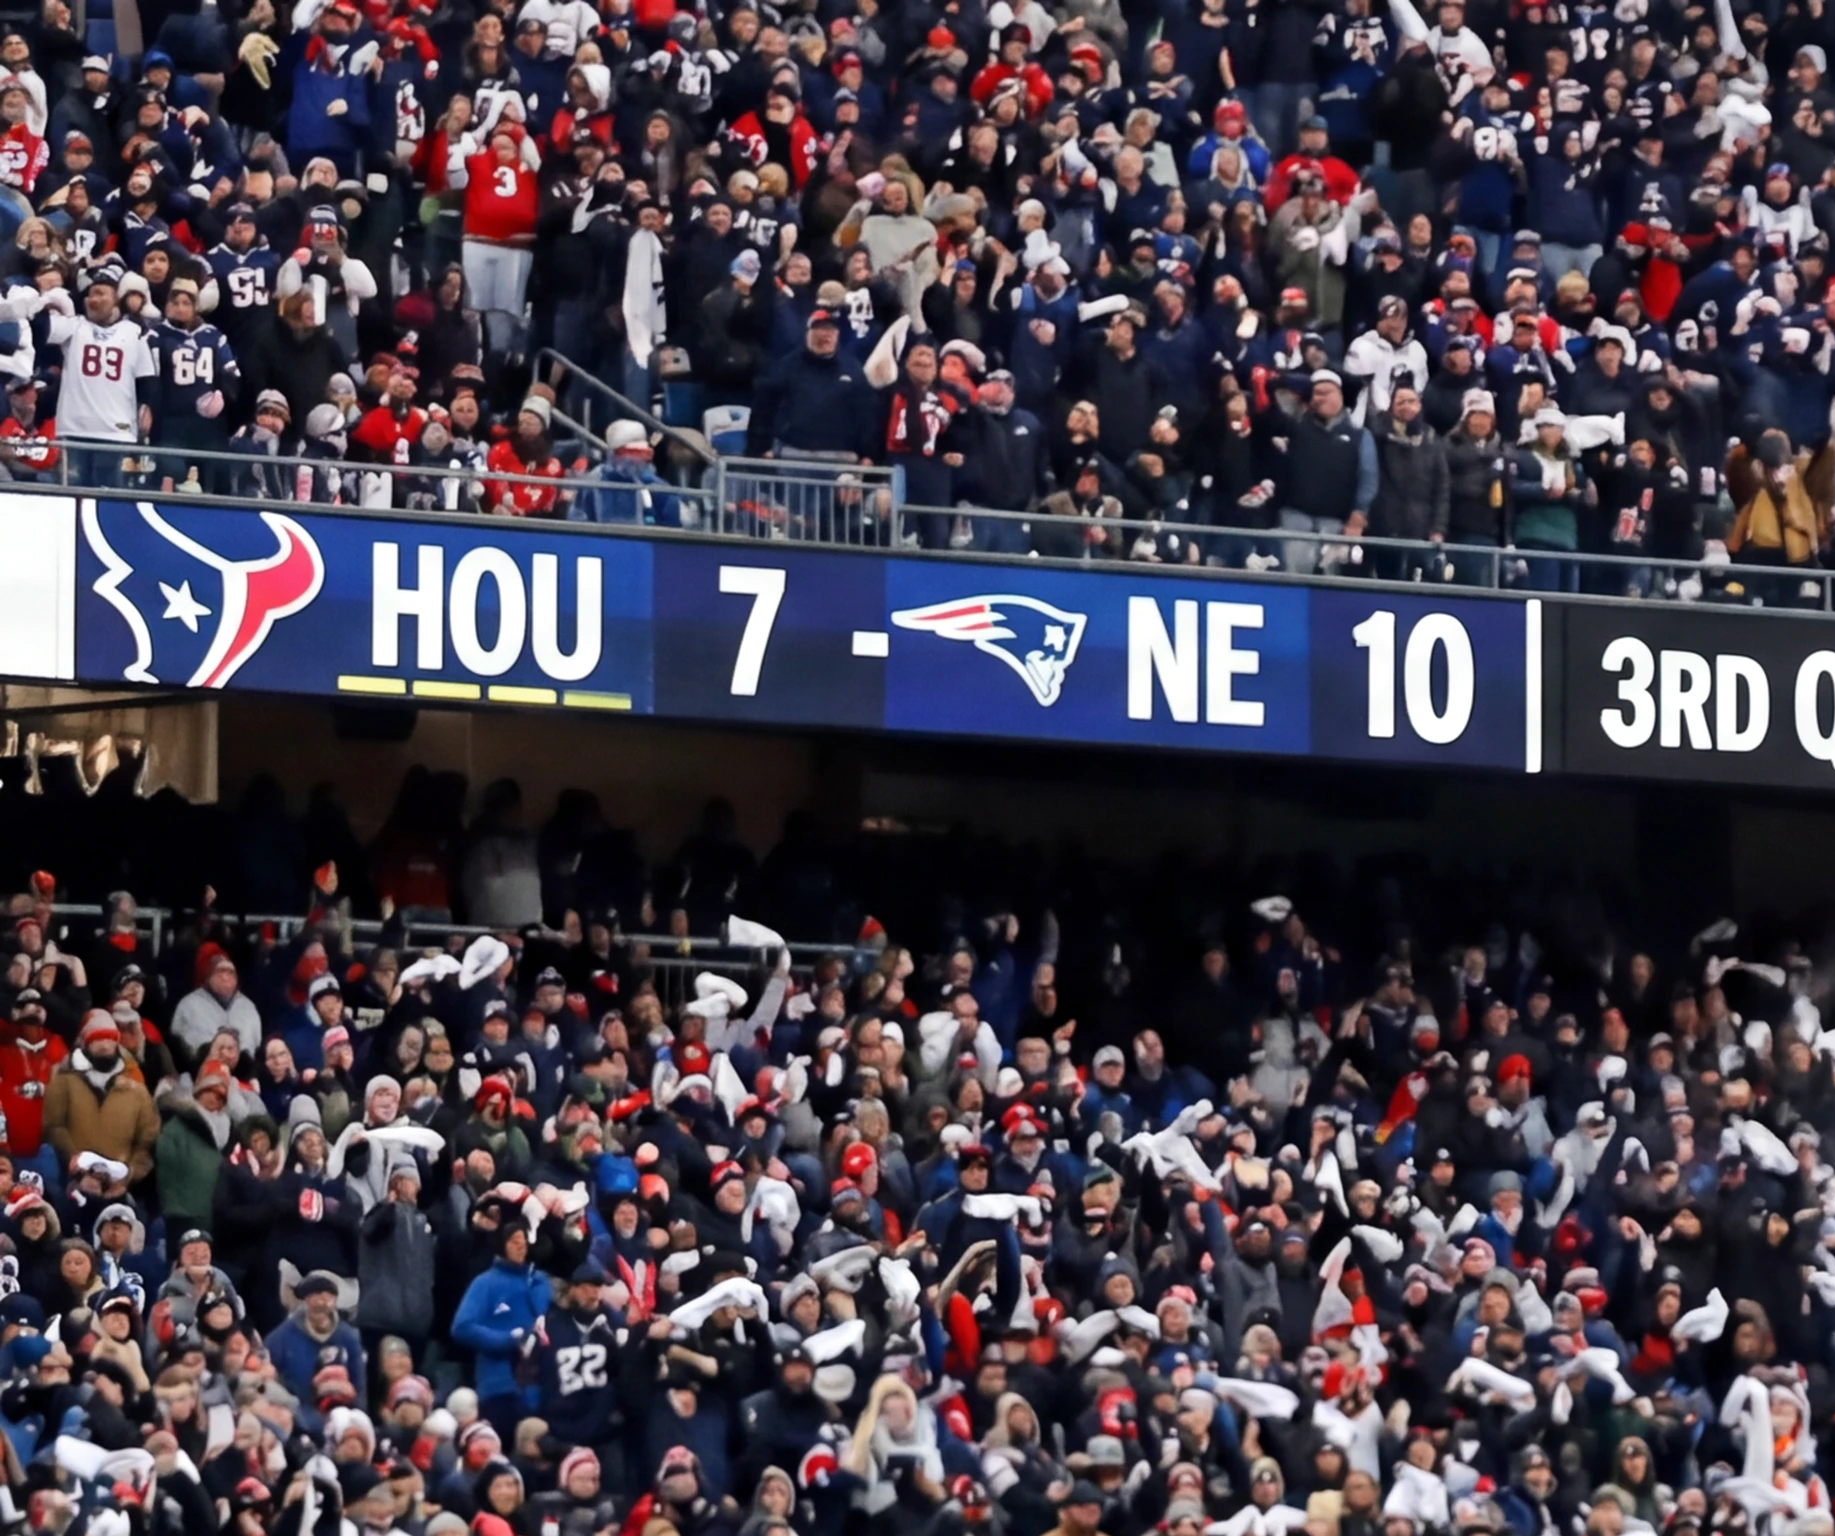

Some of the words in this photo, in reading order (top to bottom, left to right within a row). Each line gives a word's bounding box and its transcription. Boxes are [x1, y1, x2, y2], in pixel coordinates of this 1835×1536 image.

[371, 540, 603, 682] HOU
[718, 565, 787, 697] 7
[1127, 596, 1265, 727] NE
[1352, 609, 1476, 745] 10
[1599, 636, 1771, 753] 3RD
